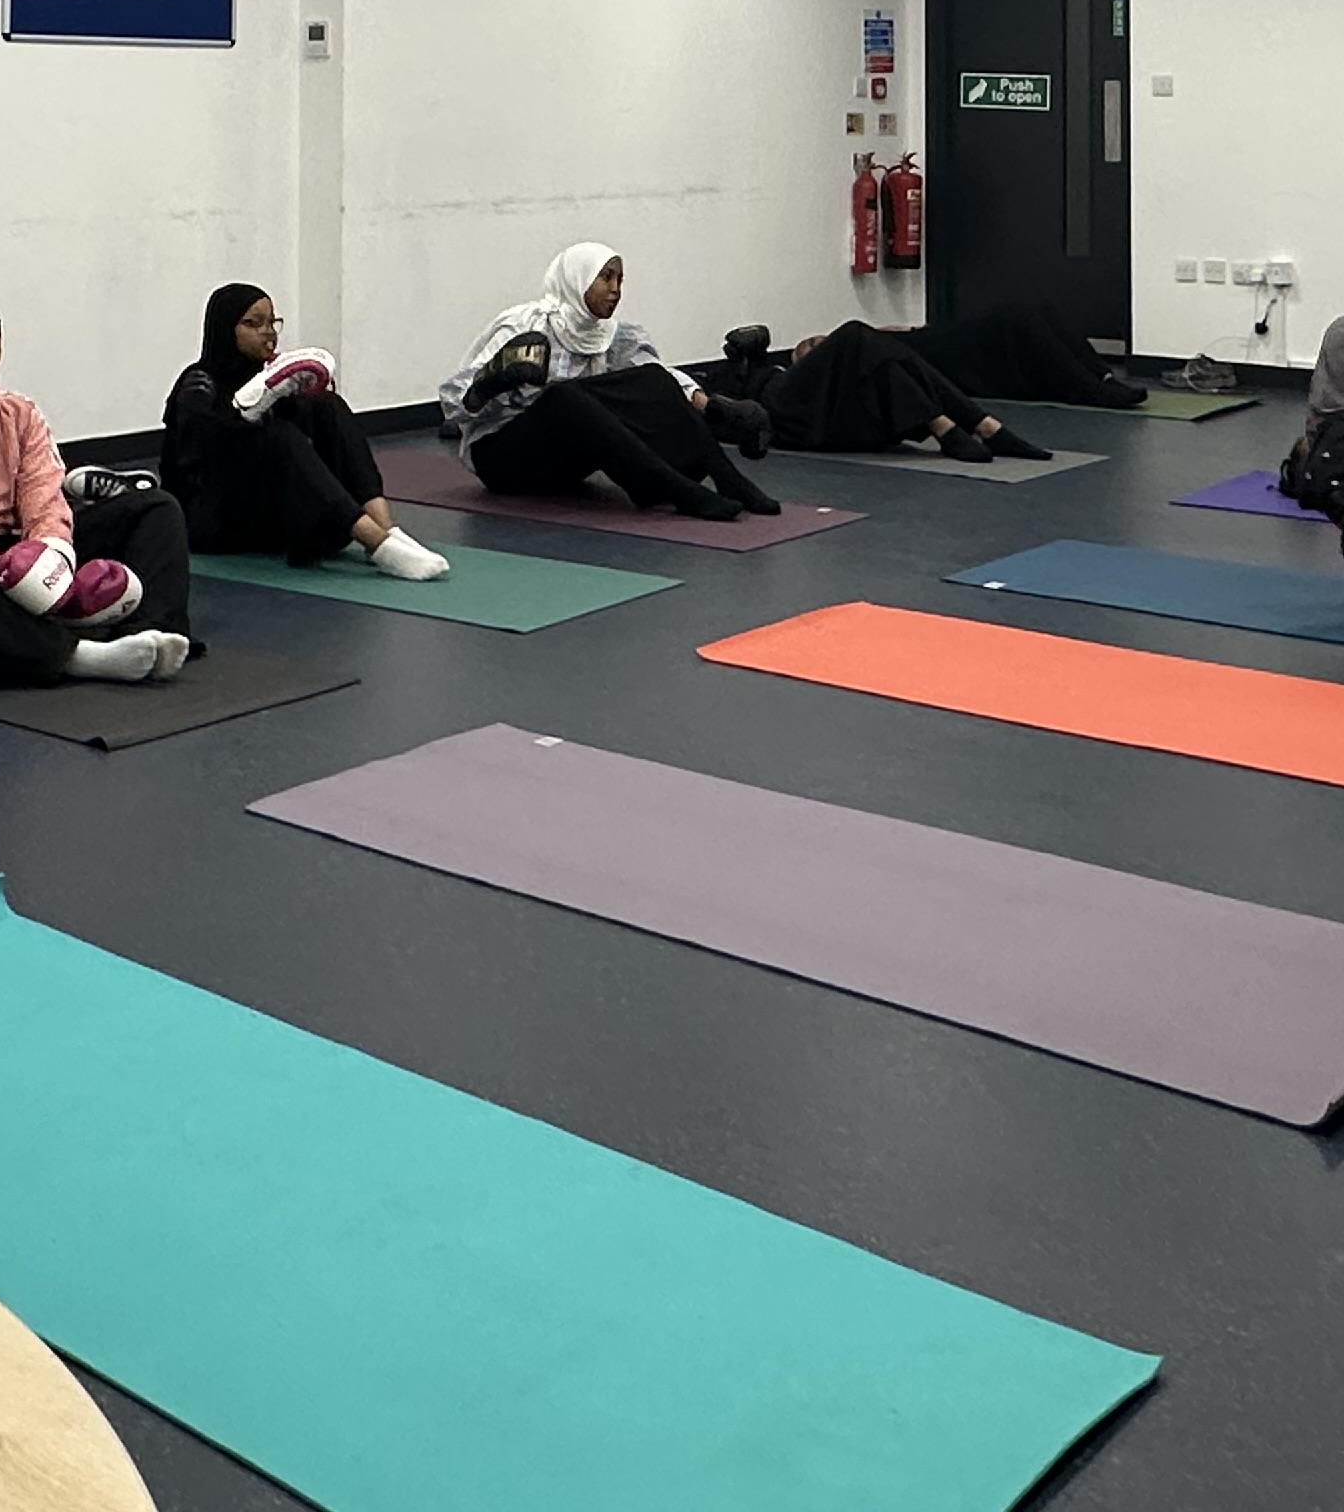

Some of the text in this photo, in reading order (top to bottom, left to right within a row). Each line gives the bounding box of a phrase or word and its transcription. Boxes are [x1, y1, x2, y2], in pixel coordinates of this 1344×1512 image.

[1000, 78, 1034, 92] Push
[991, 89, 1042, 105] to open
